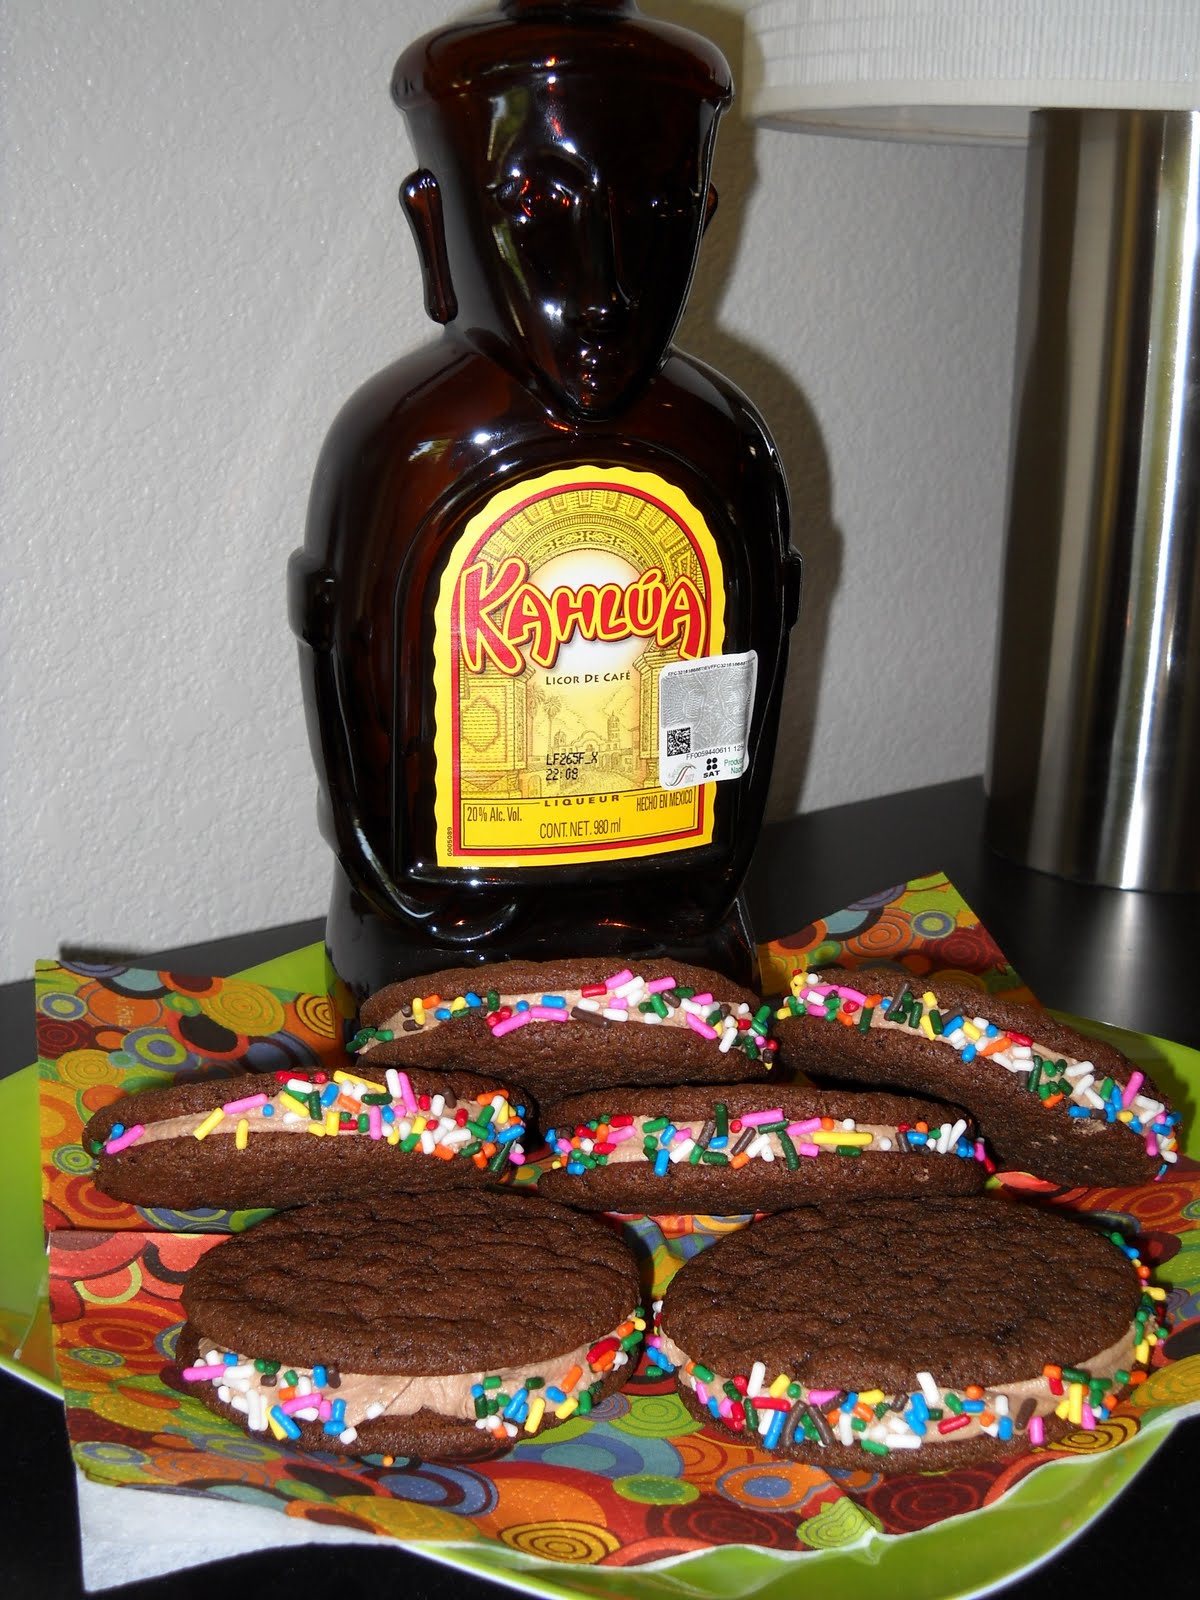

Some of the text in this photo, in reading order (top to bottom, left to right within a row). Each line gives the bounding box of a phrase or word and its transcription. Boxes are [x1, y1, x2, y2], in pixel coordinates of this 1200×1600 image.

[703, 770, 720, 778] SAT
[544, 796, 620, 807] LIQUEUR
[636, 794, 658, 812] HECHO
[659, 793, 668, 809] EN
[467, 806, 522, 822] 20% Alc. Vol.
[593, 819, 609, 834] 980
[610, 817, 621, 833] ml
